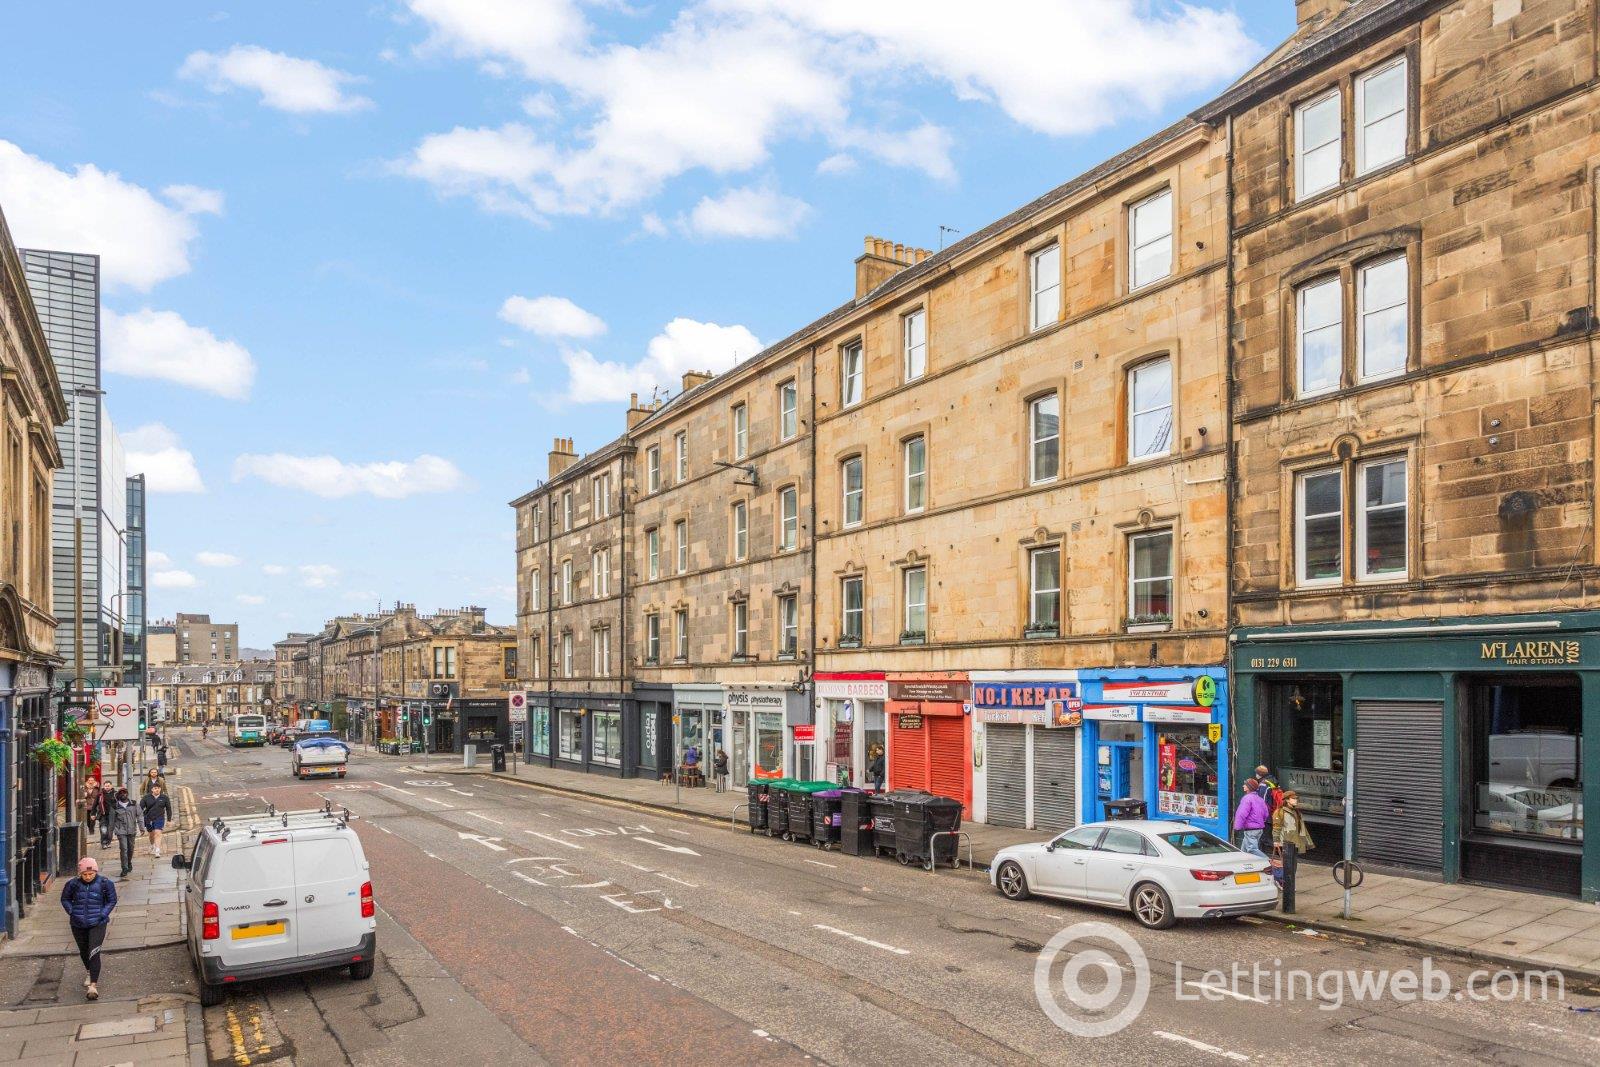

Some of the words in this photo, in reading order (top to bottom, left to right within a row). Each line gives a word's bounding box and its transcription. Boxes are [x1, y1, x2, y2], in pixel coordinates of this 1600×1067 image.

[1251, 658, 1265, 668] 0131
[1267, 658, 1280, 668] 229
[1282, 657, 1297, 667] 6311
[847, 684, 885, 696] BARBERS
[728, 692, 749, 705] physis
[750, 696, 783, 705] physiotherapy
[1068, 700, 1081, 709] OPEN
